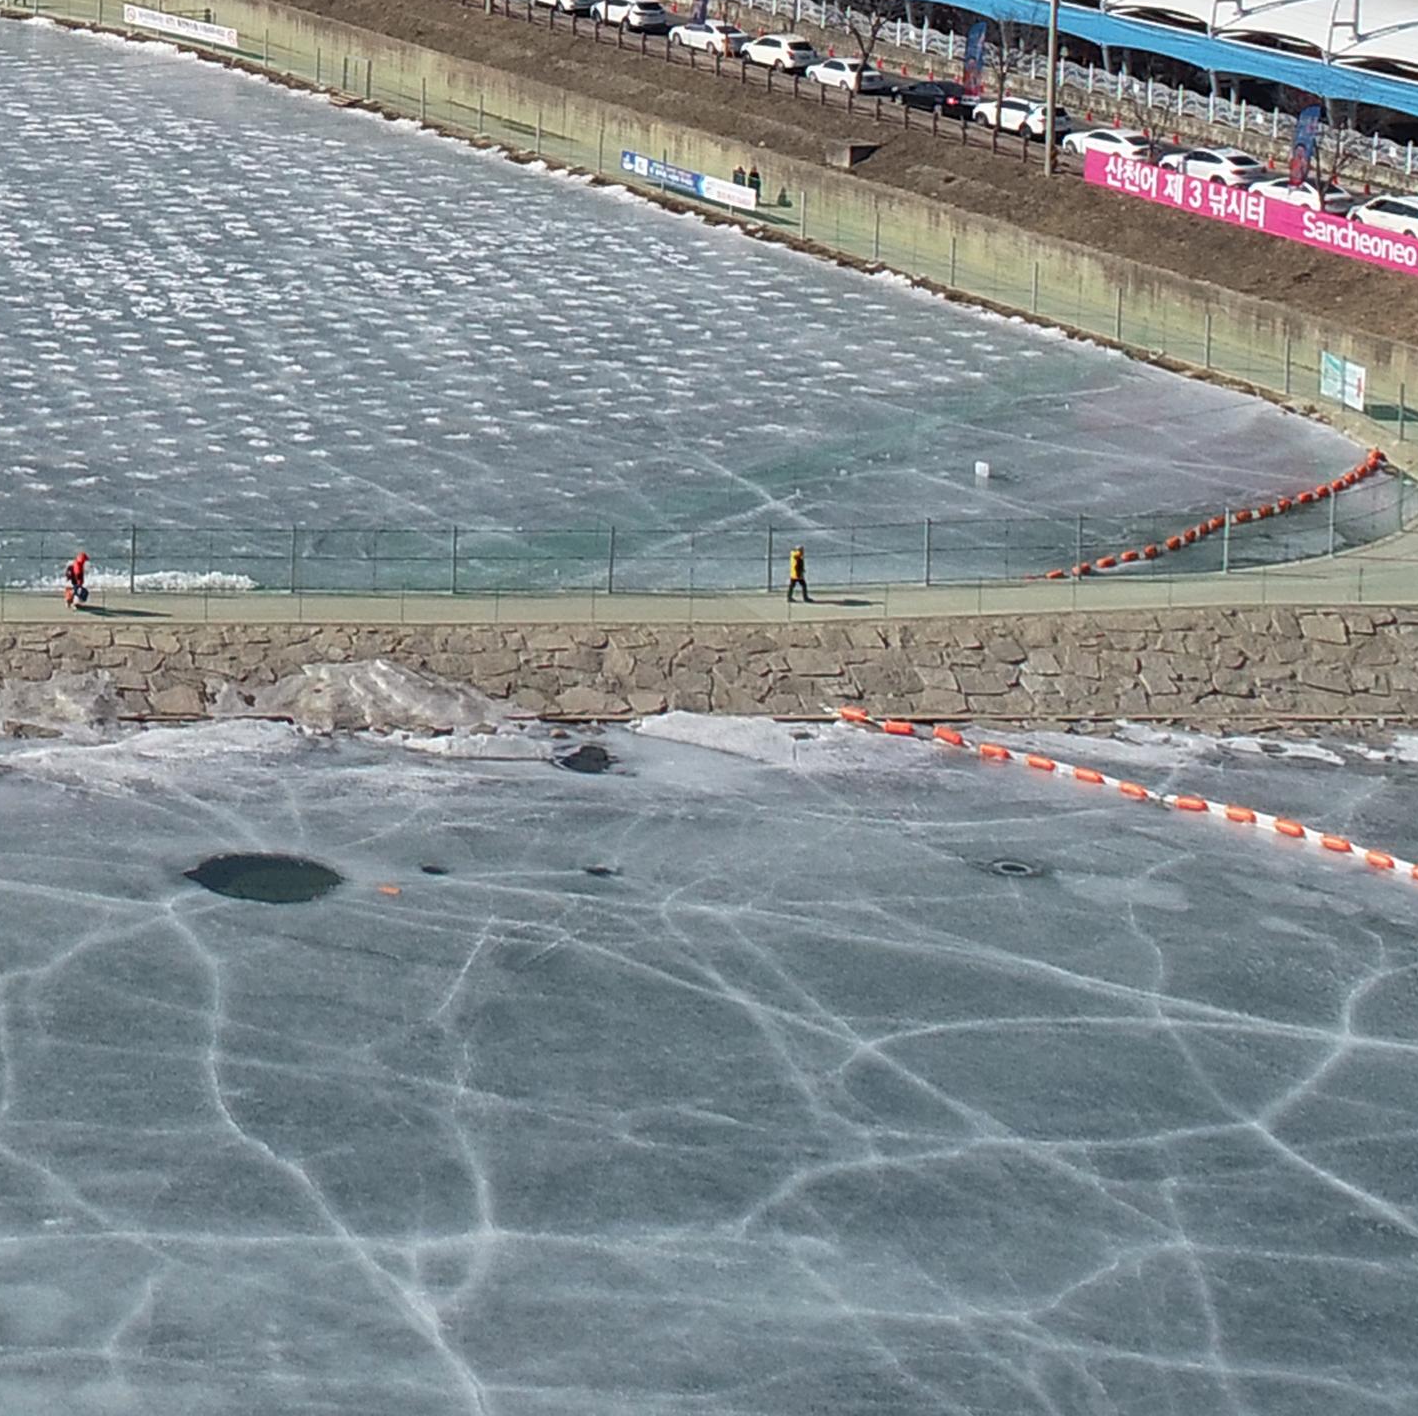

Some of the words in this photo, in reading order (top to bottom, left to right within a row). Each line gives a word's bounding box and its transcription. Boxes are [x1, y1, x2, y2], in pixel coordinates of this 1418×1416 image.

[1105, 156, 1158, 198] 산천어
[1163, 173, 1185, 205] 제
[1188, 181, 1202, 209] 3
[1208, 183, 1265, 229] 낚시터
[1302, 211, 1417, 266] Sancheoneo
